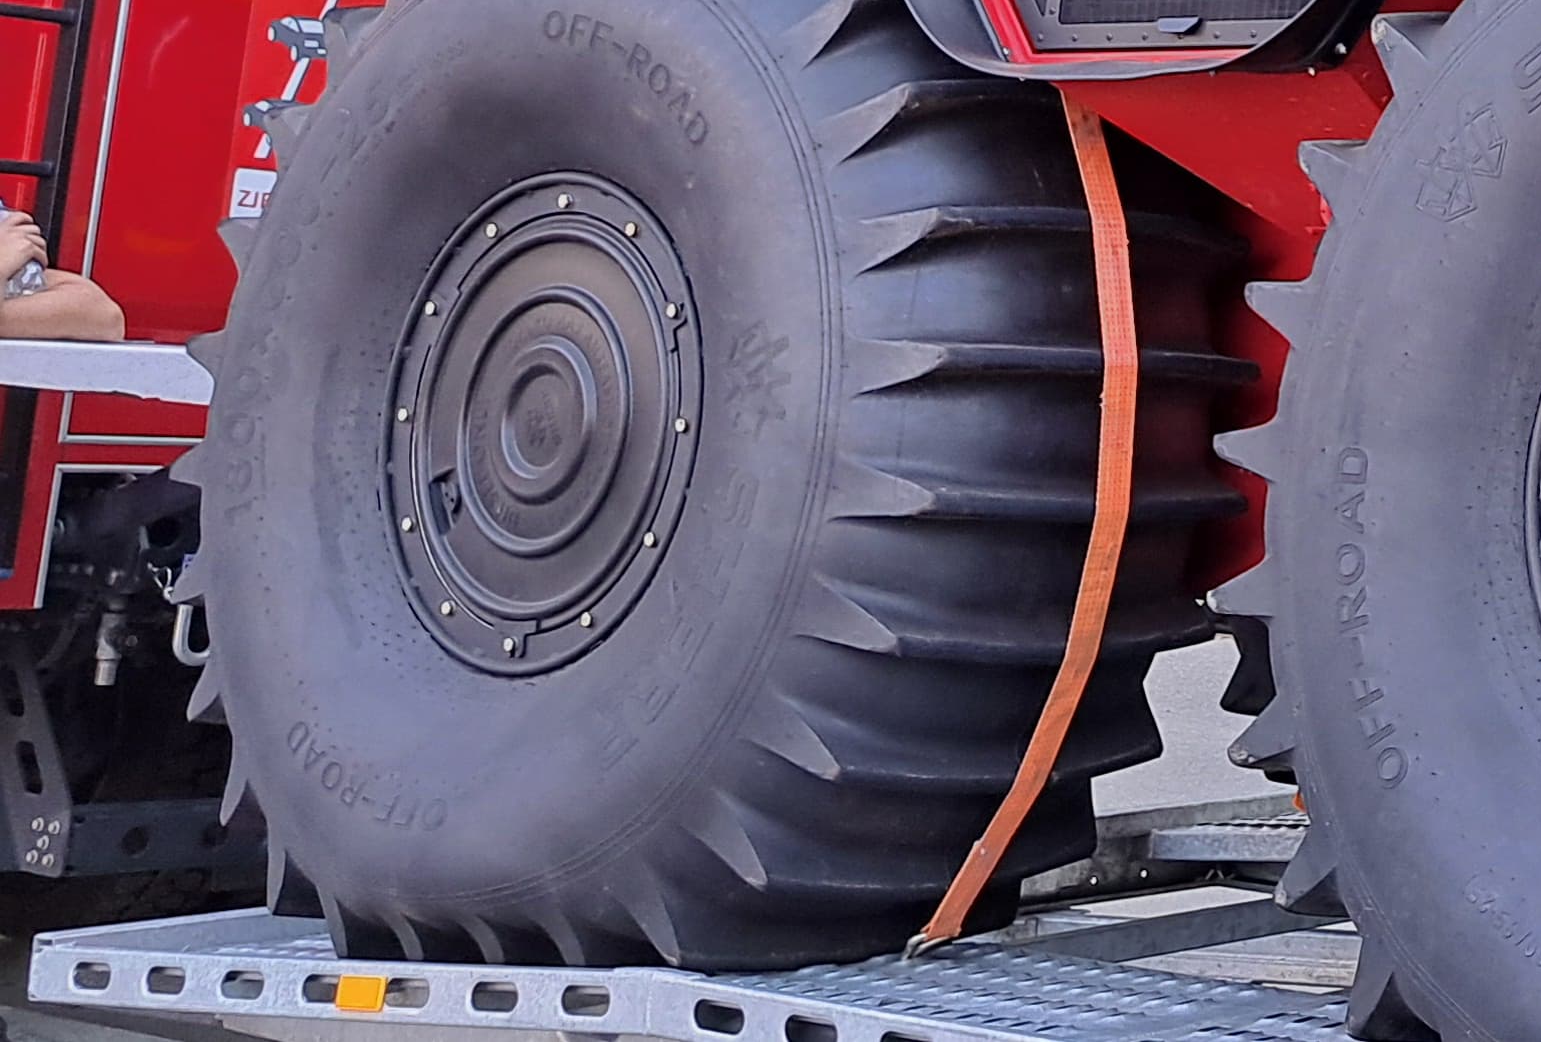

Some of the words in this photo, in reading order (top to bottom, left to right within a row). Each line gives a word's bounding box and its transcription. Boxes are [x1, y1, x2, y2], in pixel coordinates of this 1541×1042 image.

[543, 9, 711, 145] OFF-ROAD
[1337, 446, 1409, 789] OFF-ROAD
[287, 721, 448, 832] OFF-ROAD
